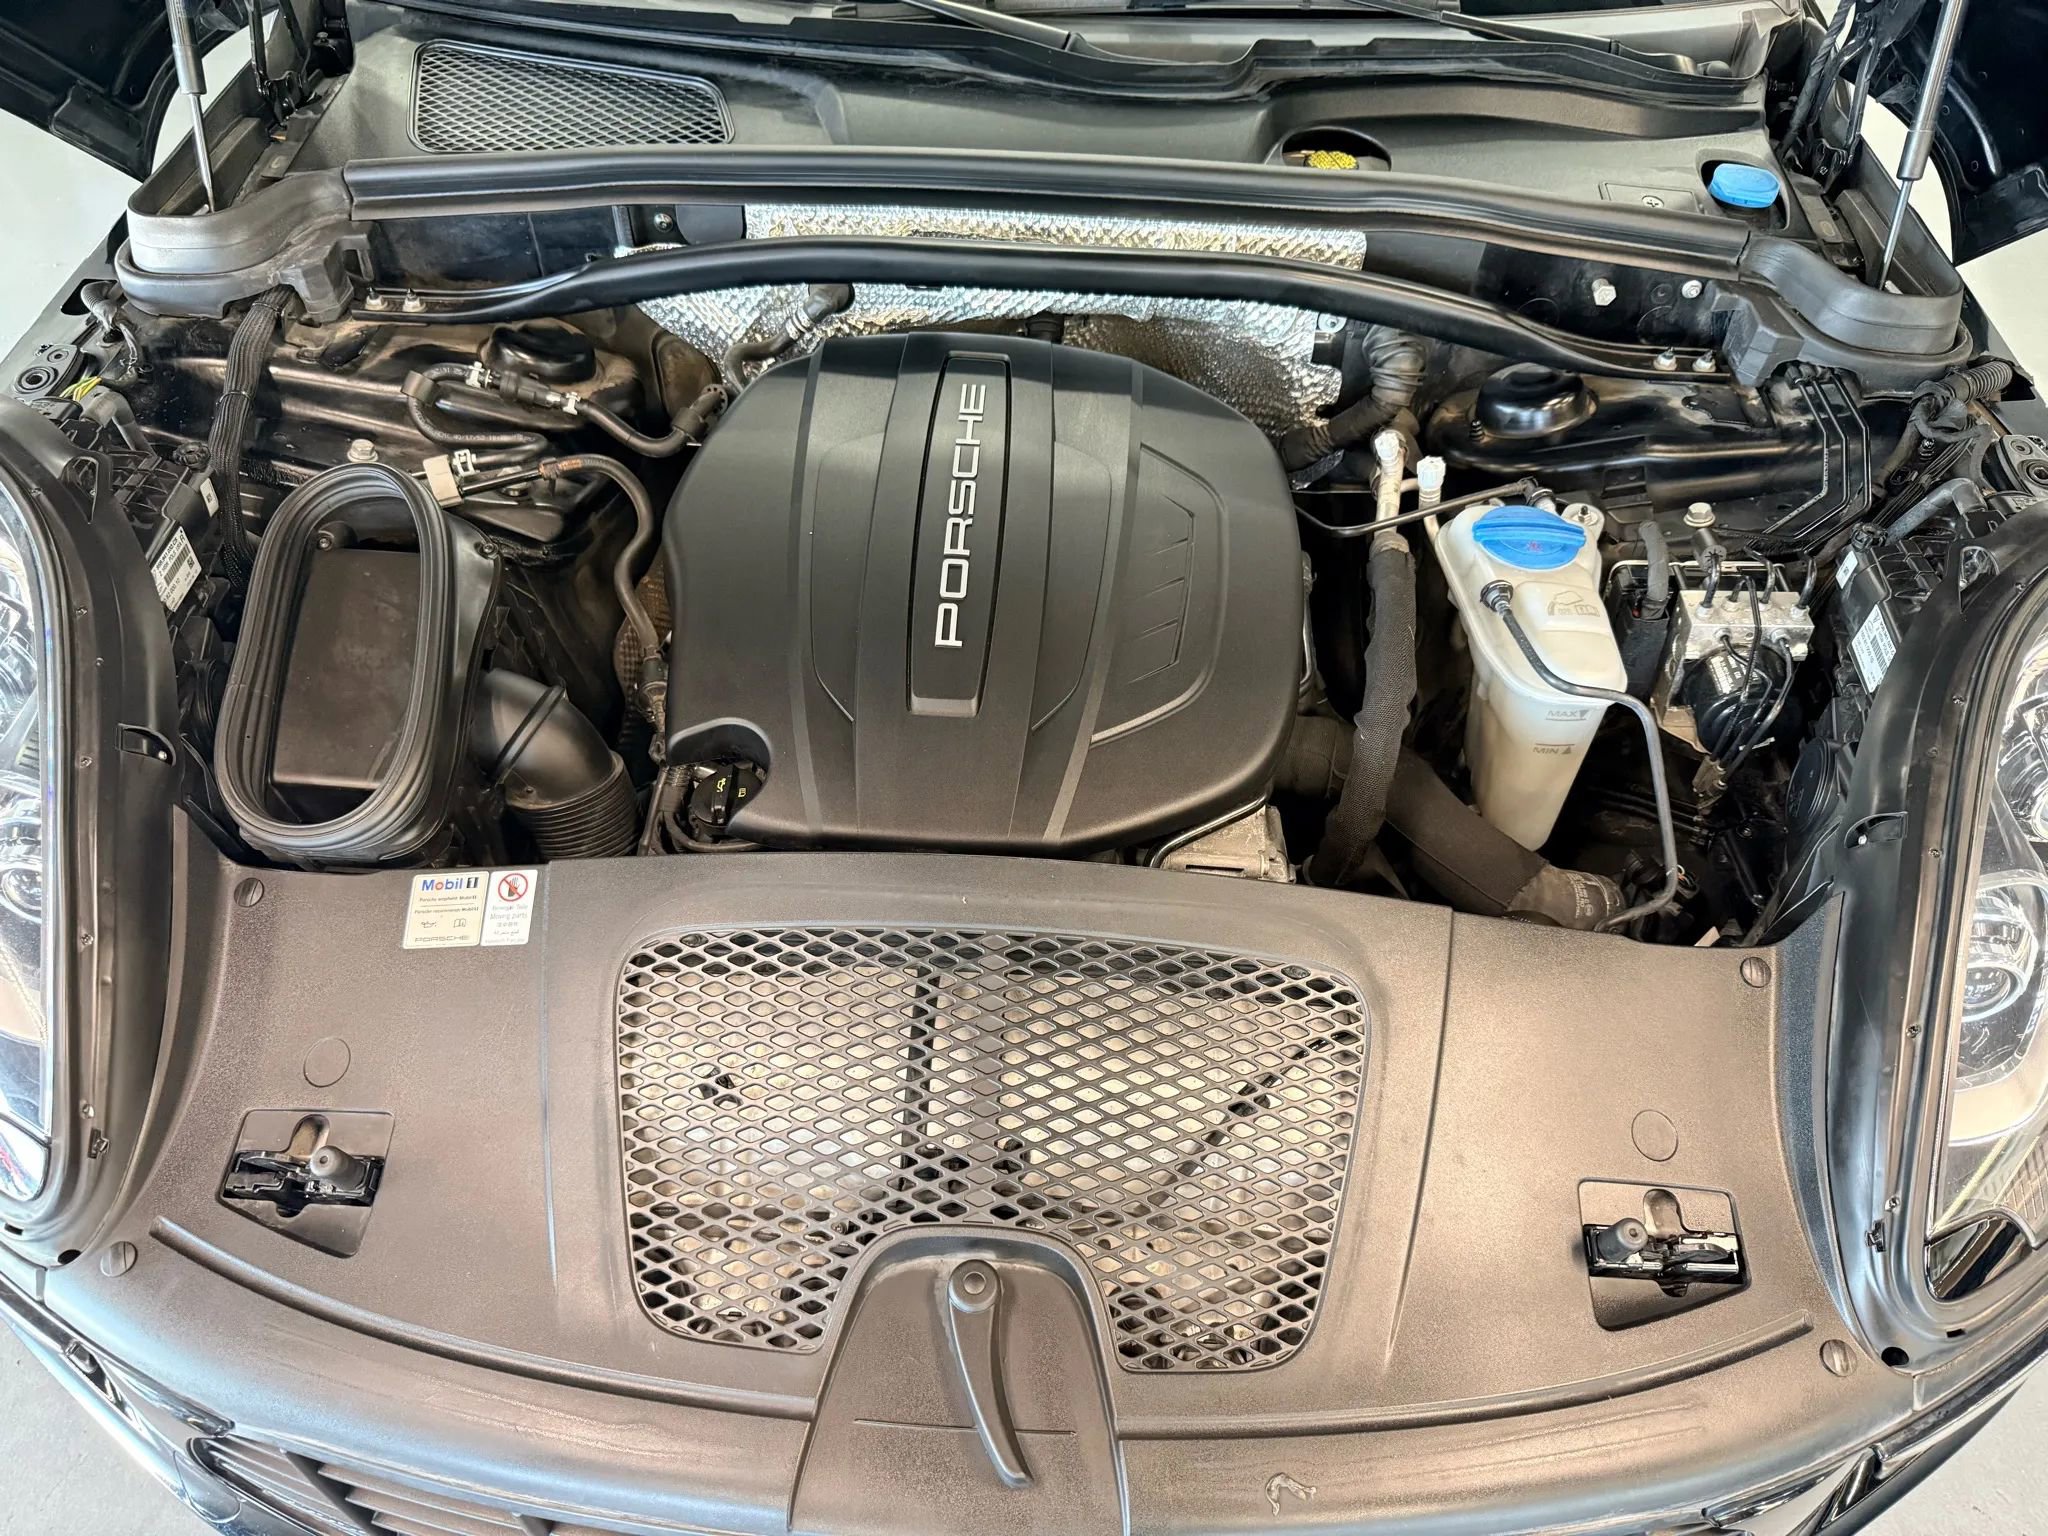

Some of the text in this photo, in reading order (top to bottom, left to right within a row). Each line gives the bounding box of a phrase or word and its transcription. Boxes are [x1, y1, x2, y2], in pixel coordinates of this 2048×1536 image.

[934, 383, 986, 647] PORSCHE
[1547, 710, 1578, 718] MAX
[1532, 746, 1560, 754] MIN
[421, 877, 479, 891] Mobil 1
[415, 935, 471, 943] PORSCHE
